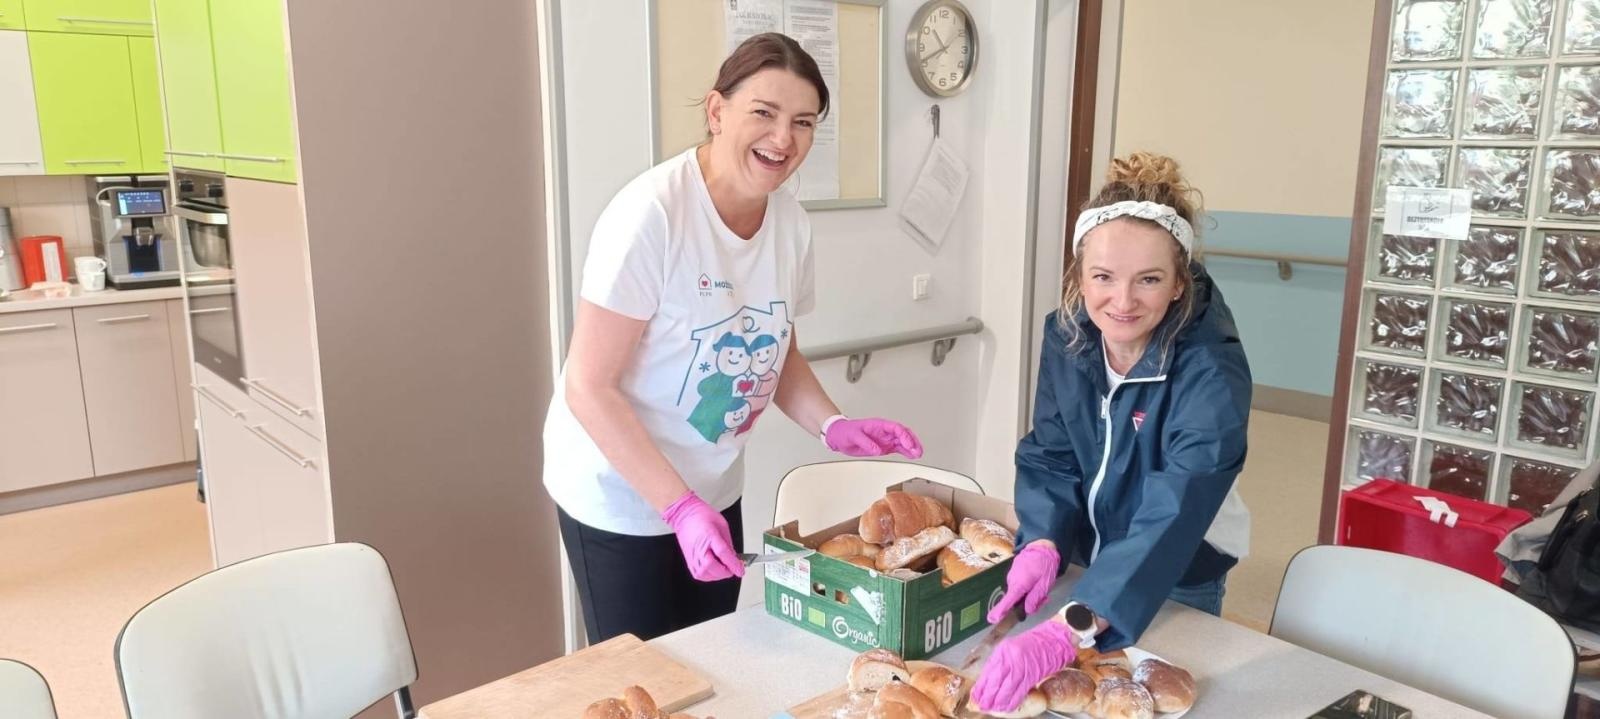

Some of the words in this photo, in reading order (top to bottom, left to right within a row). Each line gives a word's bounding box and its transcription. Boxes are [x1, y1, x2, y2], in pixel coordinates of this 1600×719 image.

[939, 9, 950, 19] 12
[929, 15, 937, 24] 11
[960, 46, 969, 55] 3
[927, 71, 936, 80] 7
[950, 72, 957, 81] 5
[938, 78, 947, 87] 6
[832, 615, 881, 648] Organic
